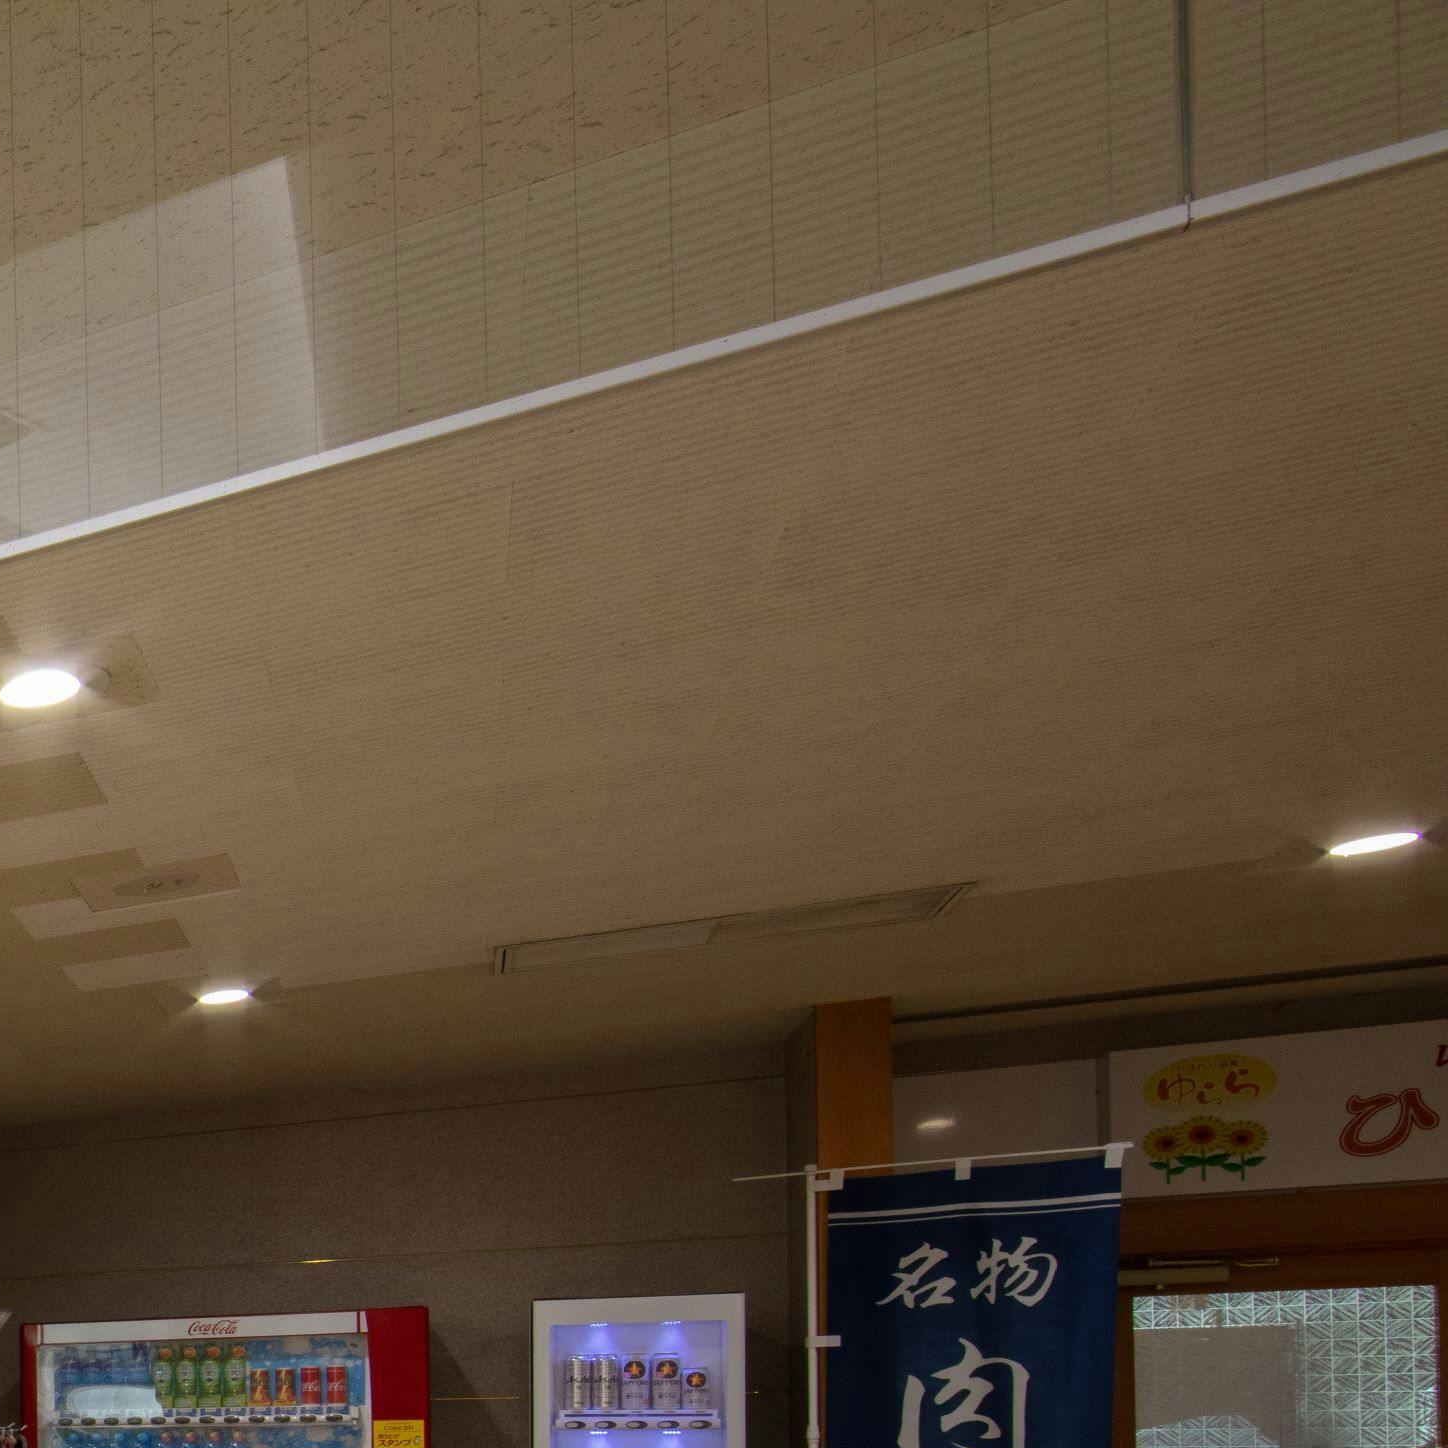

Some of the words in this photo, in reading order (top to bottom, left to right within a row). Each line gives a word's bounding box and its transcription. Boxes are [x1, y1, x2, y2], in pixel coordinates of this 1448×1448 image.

[1157, 1068, 1260, 1105] ゆらら
[875, 1237, 1058, 1312] 名物
[188, 1319, 240, 1336] Coca-Cola
[377, 1438, 412, 1447] スタンプ
